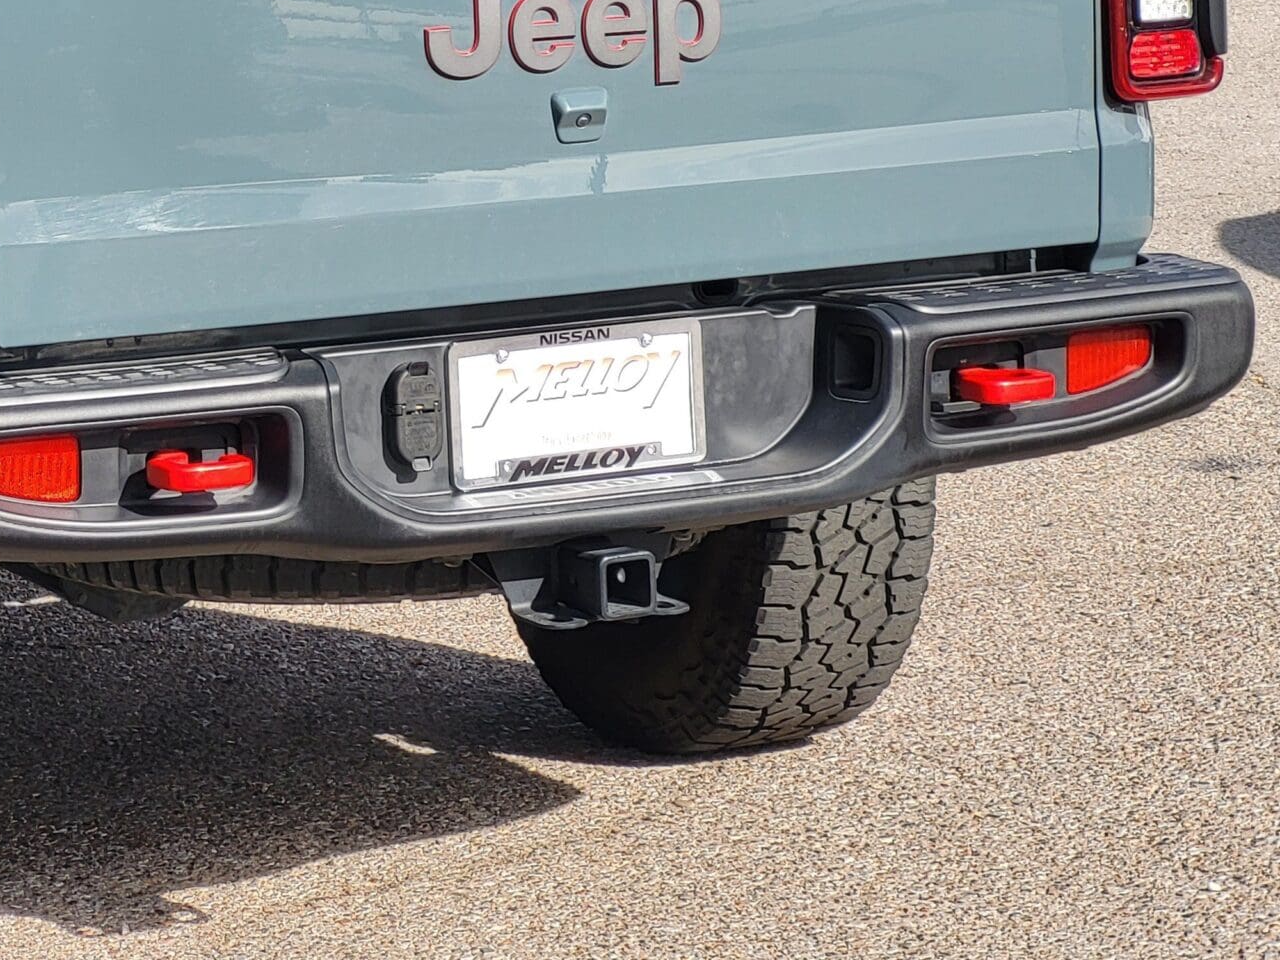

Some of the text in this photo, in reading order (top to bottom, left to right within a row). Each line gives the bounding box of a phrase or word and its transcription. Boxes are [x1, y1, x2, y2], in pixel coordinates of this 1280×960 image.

[539, 327, 610, 346] NISSAN
[471, 350, 681, 429] MELLOY
[508, 445, 648, 482] MELLOY
